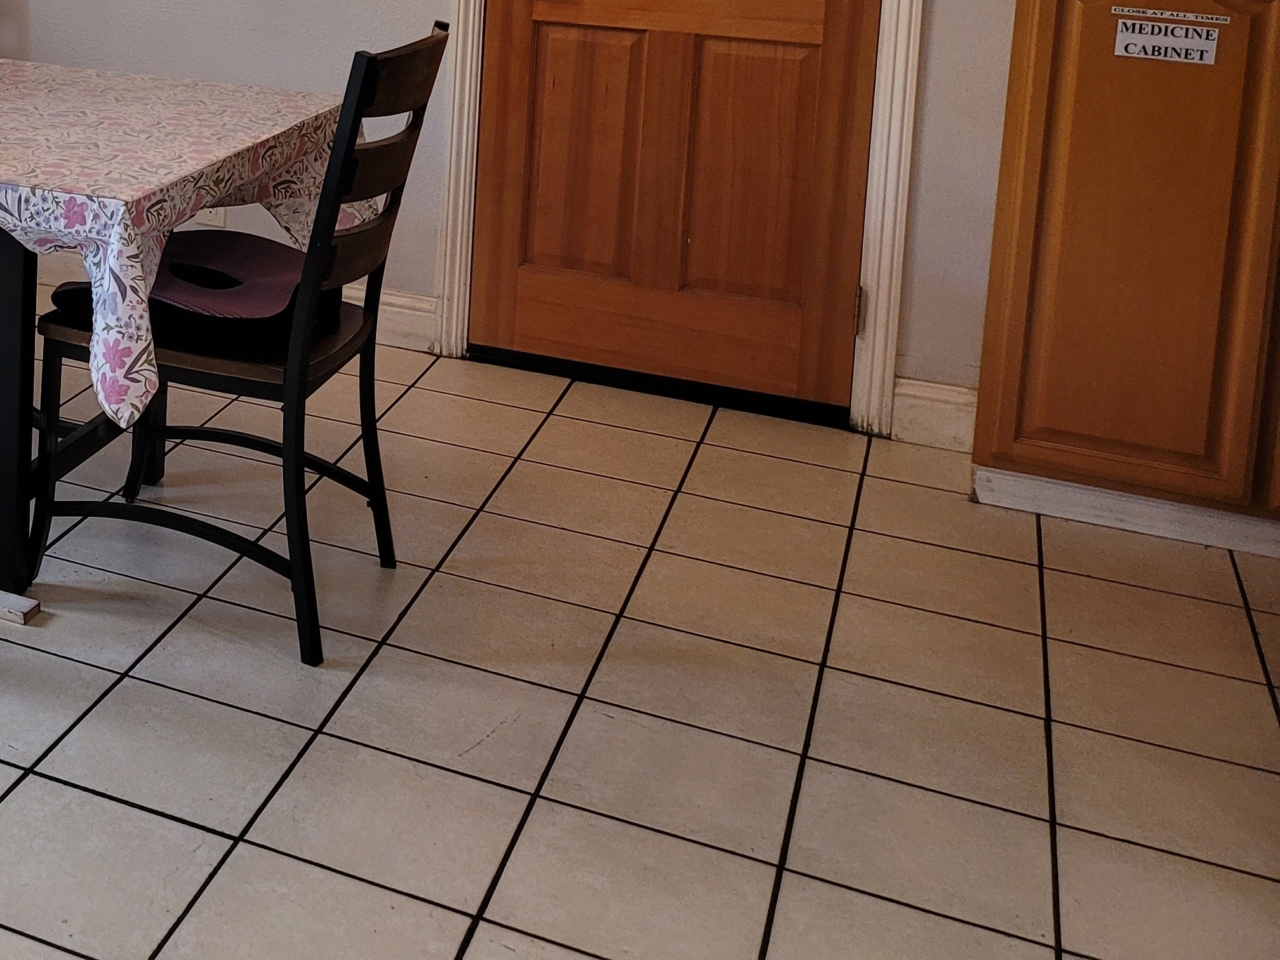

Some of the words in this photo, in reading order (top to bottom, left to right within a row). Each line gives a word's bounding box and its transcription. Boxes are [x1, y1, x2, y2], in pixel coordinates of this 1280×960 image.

[1113, 7, 1149, 15] CLOSE
[1193, 14, 1228, 22] TIMES
[1120, 21, 1216, 41] MEDICINE
[1124, 43, 1208, 61] CABINET
